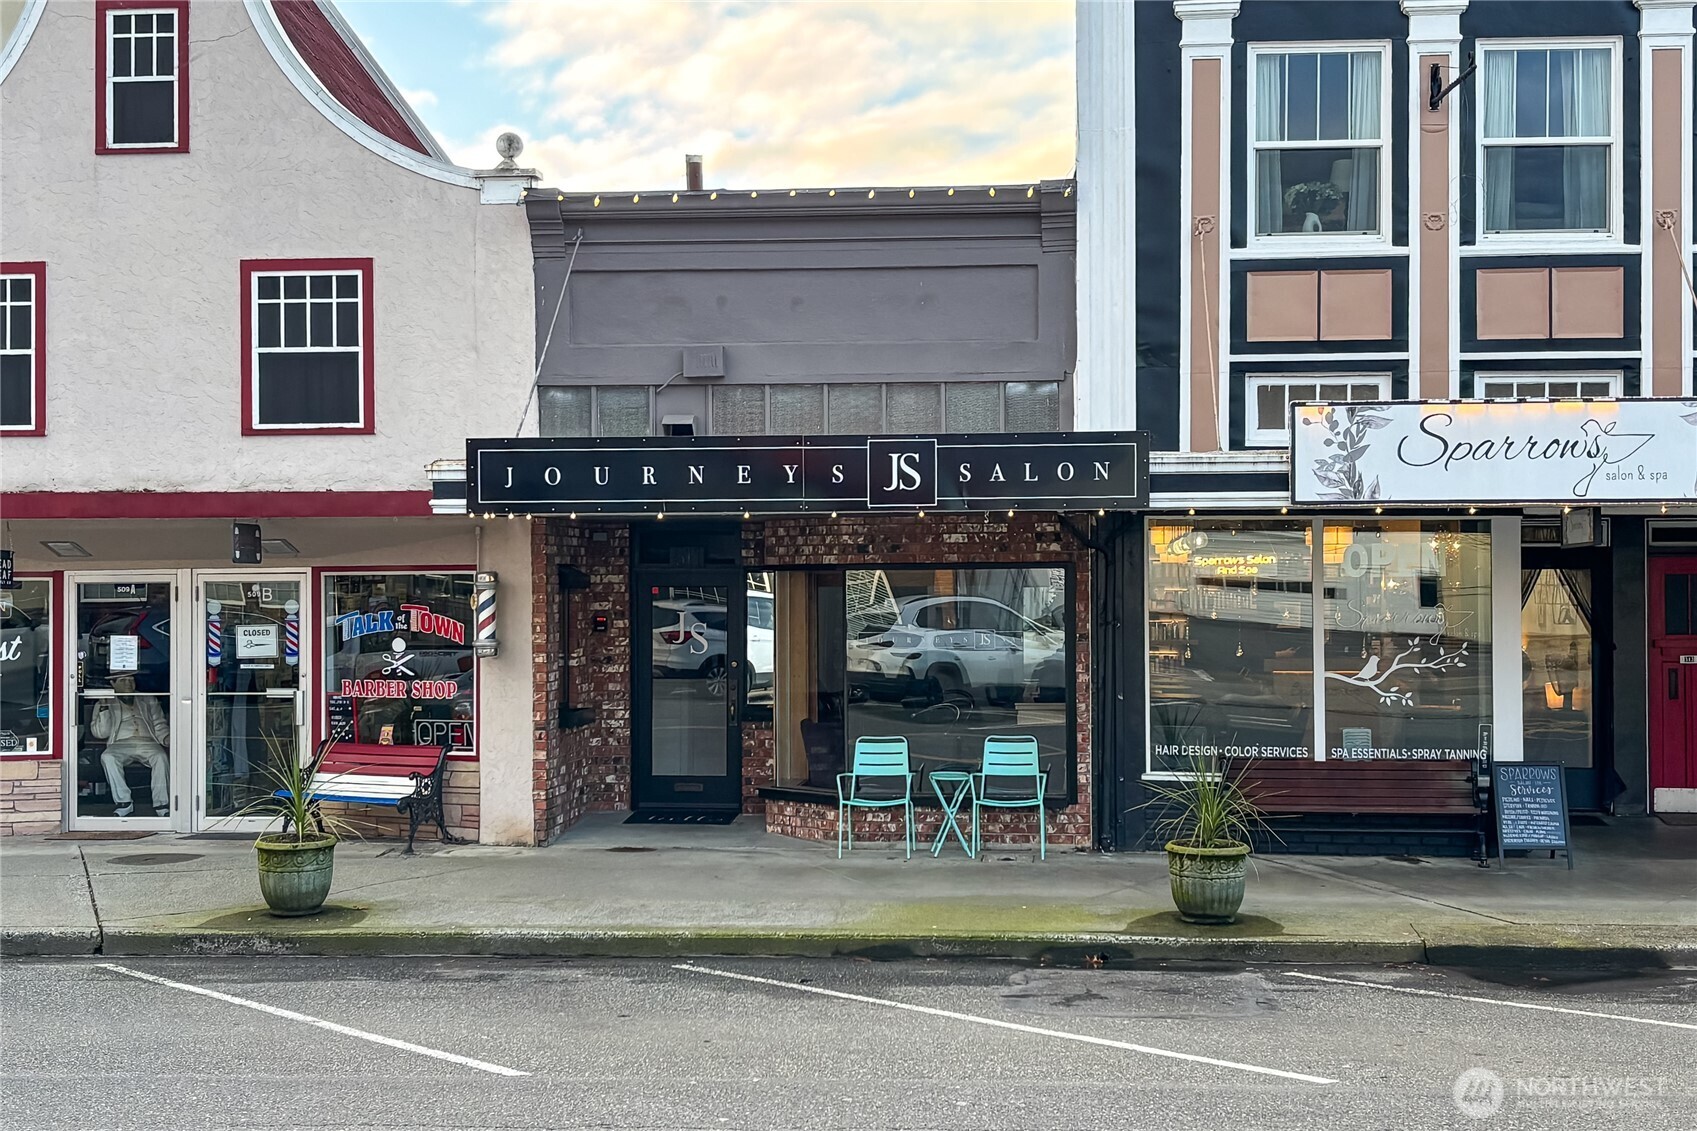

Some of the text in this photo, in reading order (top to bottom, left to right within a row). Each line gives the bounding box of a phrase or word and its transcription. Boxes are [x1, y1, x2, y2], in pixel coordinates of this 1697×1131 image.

[1397, 413, 1607, 472] Sparrows
[505, 453, 1111, 491] JOURNEYS JS SALON
[1605, 464, 1668, 484] salon & spa
[335, 610, 394, 641] TALK
[395, 622, 408, 630] the
[396, 613, 406, 622] of
[400, 604, 465, 646] TOWN
[243, 629, 271, 637] CLOSED
[341, 679, 458, 700] BARBER SHOP
[1155, 744, 1309, 758] HAIR DESIGN COLOR SERVICES
[1331, 748, 1487, 760] SPA ESSENTIALS SPRAY TANNING
